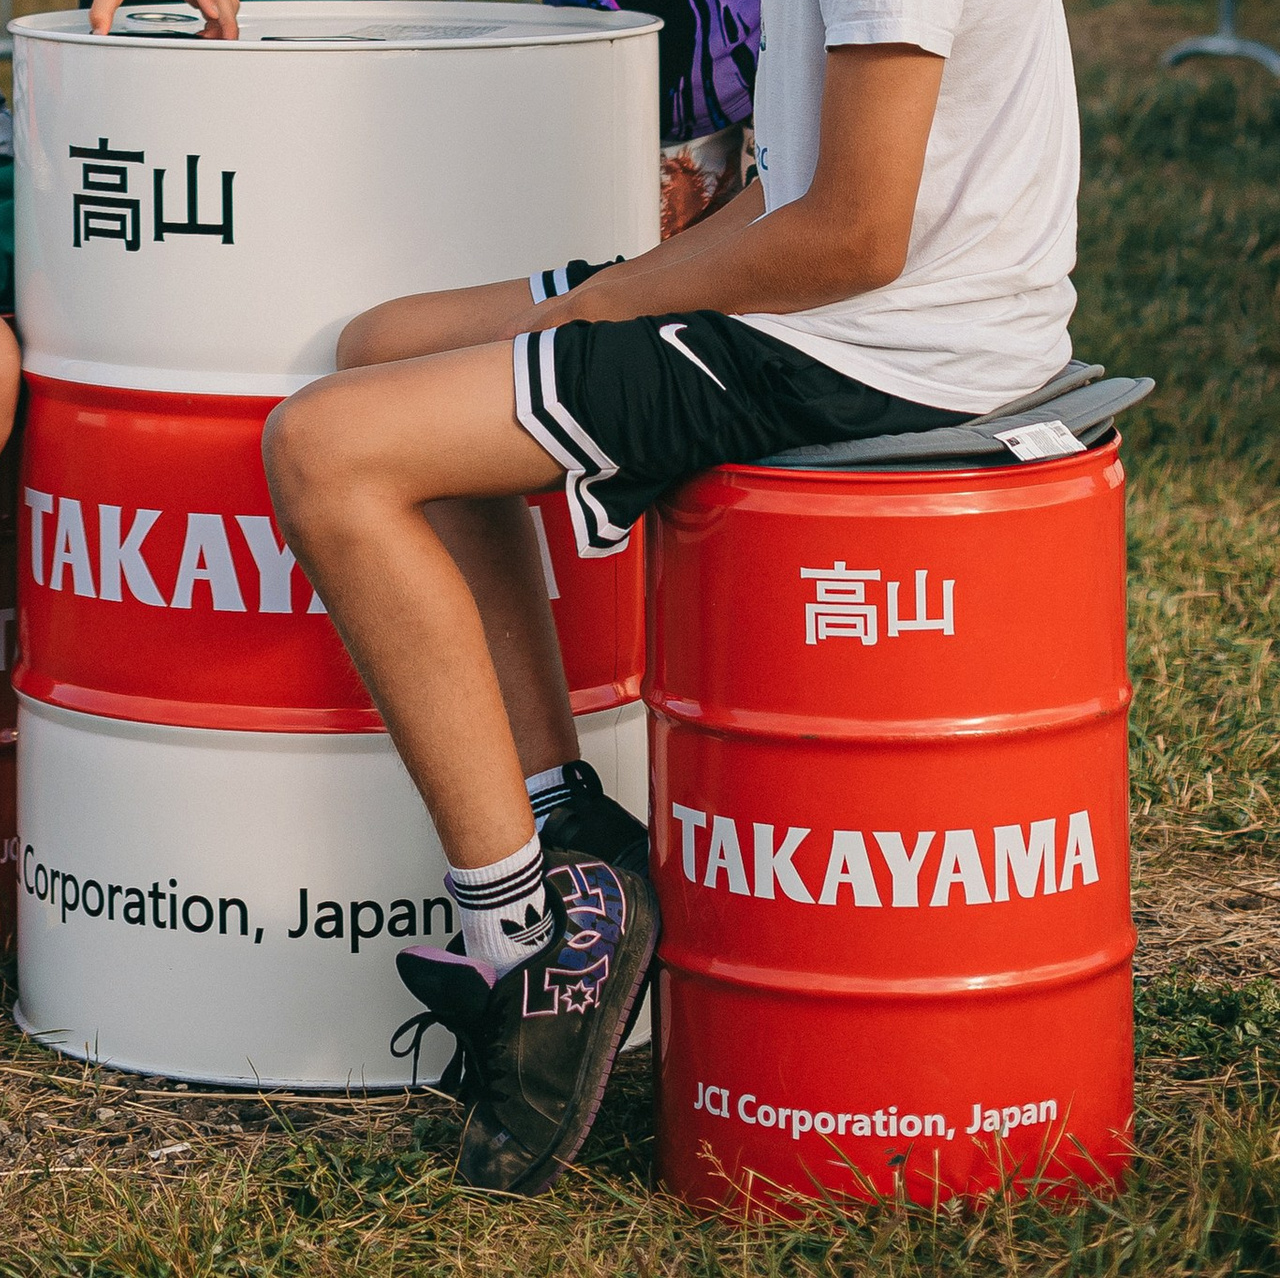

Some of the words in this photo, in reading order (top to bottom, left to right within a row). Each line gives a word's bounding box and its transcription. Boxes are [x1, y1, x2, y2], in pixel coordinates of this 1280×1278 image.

[68, 137, 237, 252] 高山
[799, 560, 956, 646] 高山
[23, 844, 265, 944] Corporation,
[287, 888, 454, 954] Japan
[672, 801, 1100, 908] TAKAYAMA
[694, 1081, 731, 1119] JCI
[737, 1093, 956, 1141] Corporation,
[966, 1098, 1058, 1138] Japan
